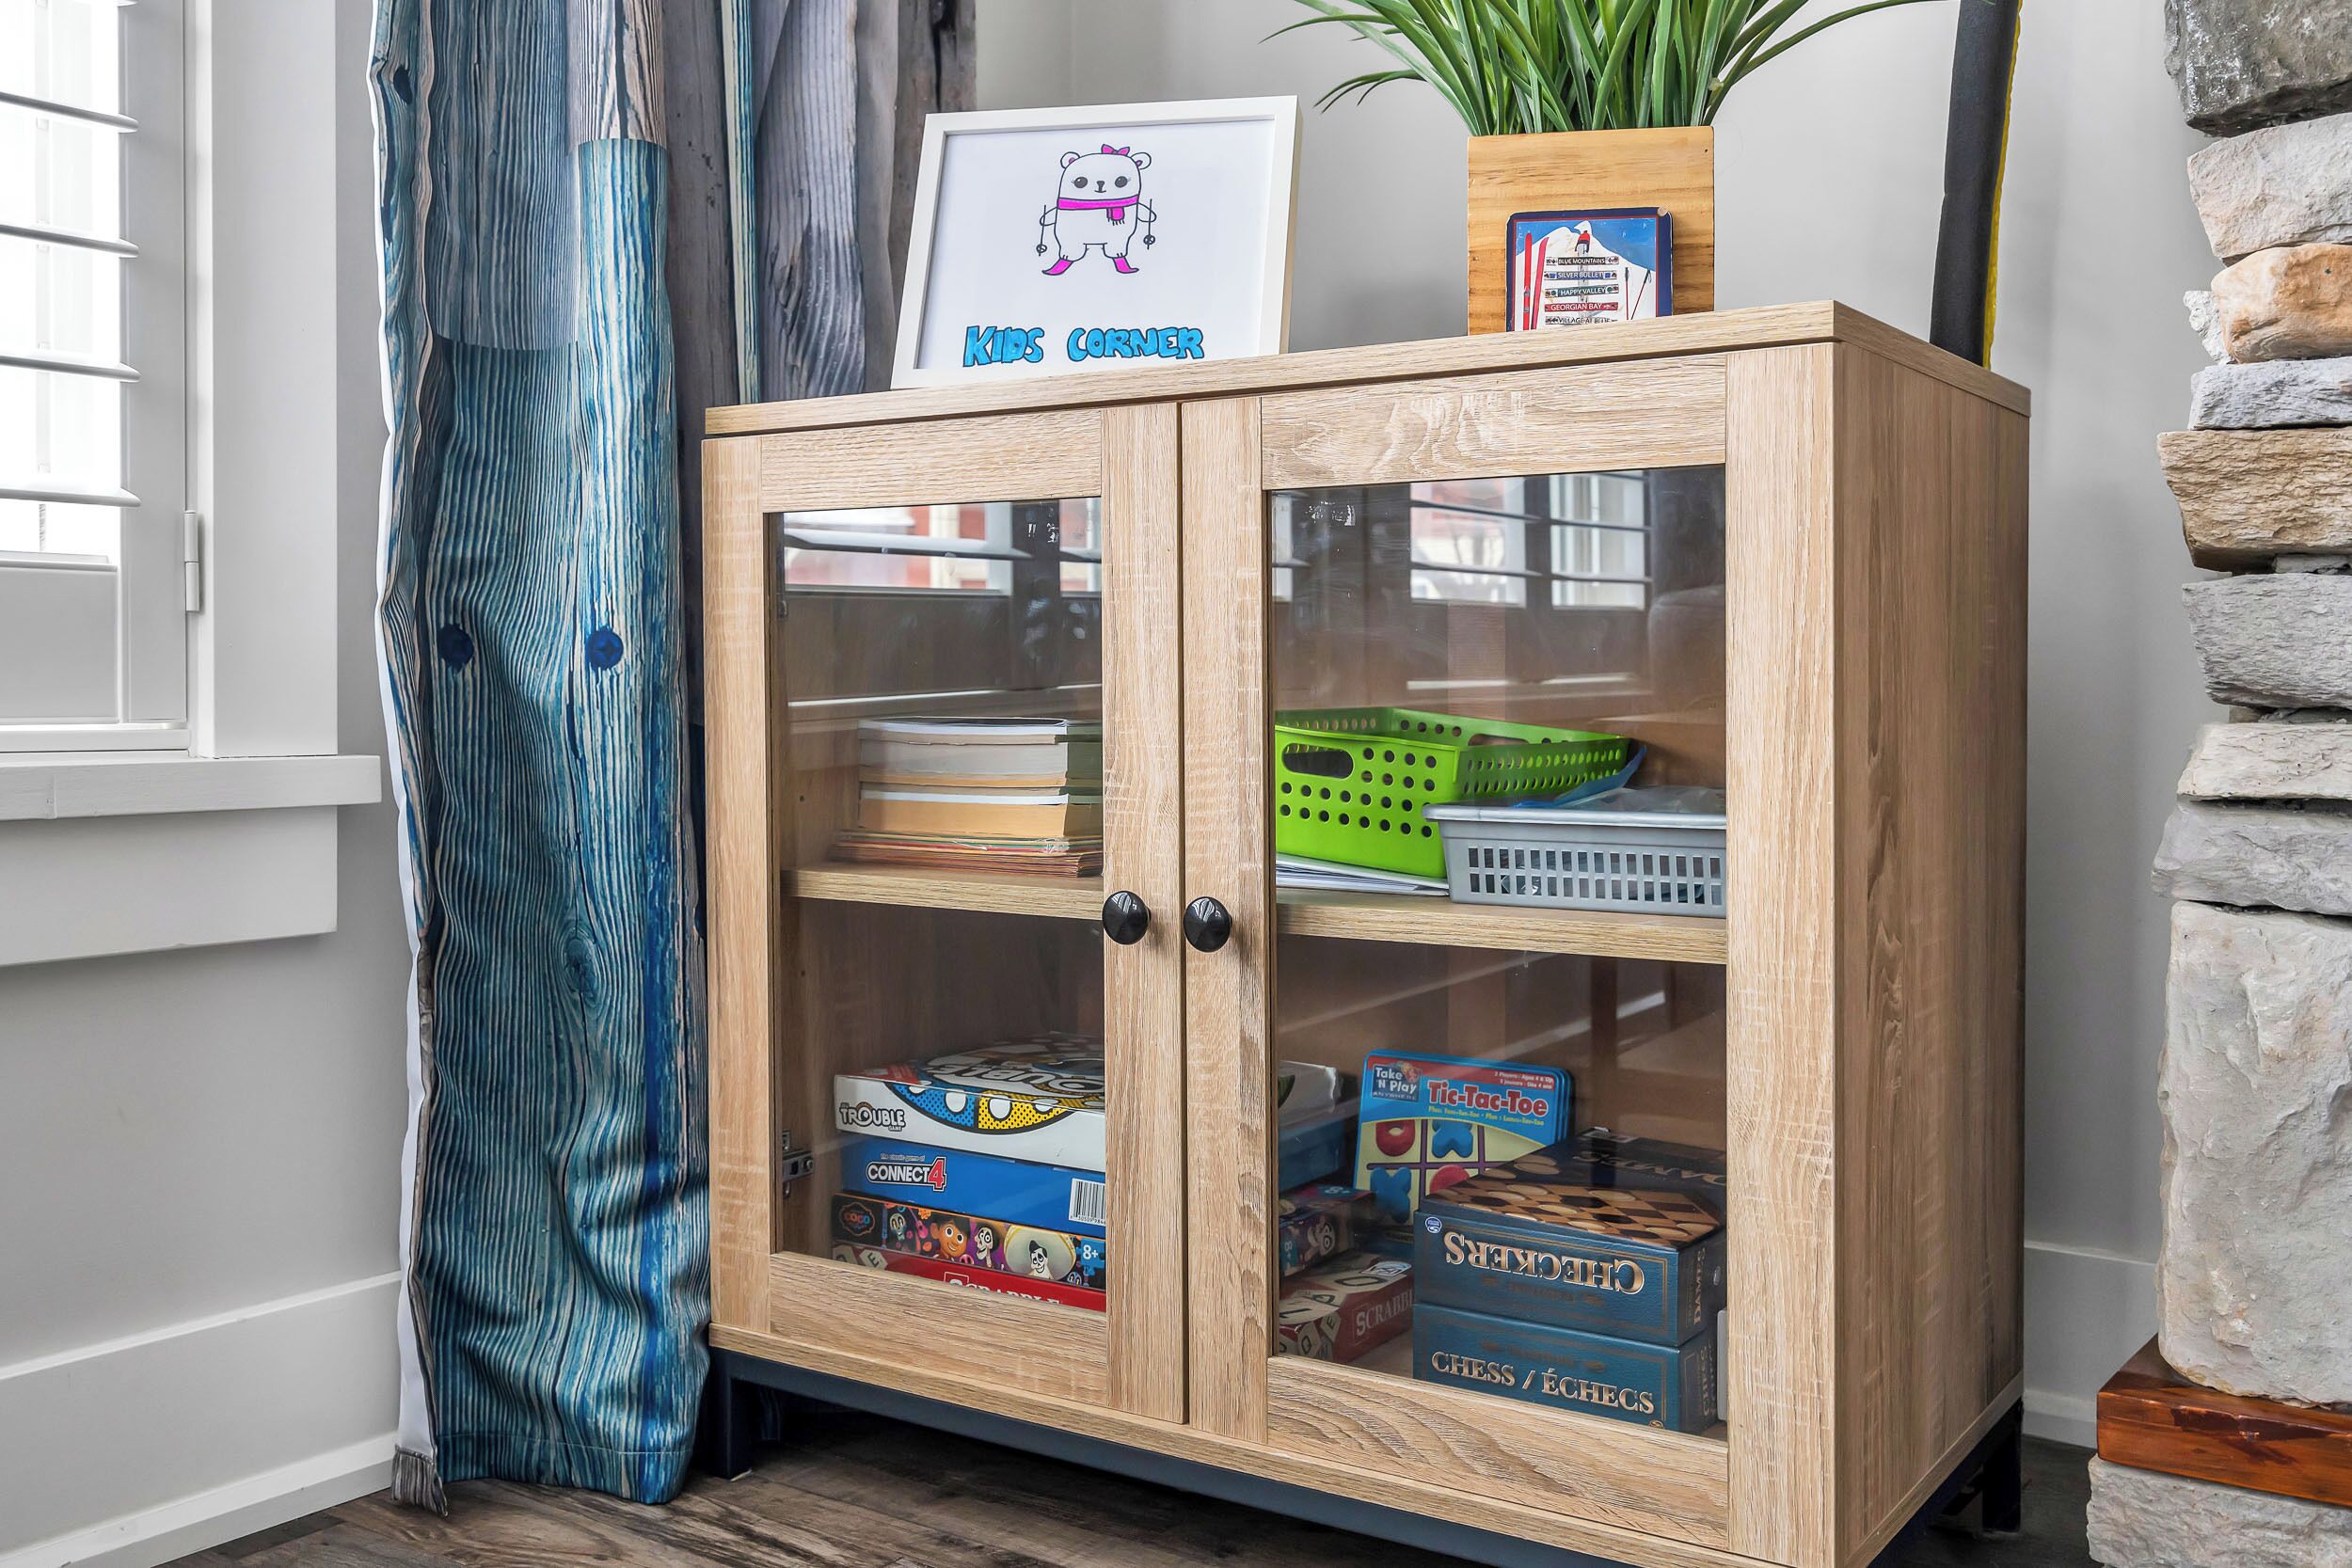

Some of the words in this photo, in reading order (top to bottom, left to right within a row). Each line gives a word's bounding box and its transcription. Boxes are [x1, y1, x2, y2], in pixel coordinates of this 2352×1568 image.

[1550, 303, 1587, 311] GEORGIAN
[962, 325, 1044, 368] KIDS
[1067, 326, 1204, 362] CORNER
[1375, 1067, 1404, 1081] Take
[1390, 1080, 1418, 1095] Play
[1427, 1080, 1549, 1117] Tic-Tac-Toe
[839, 1104, 907, 1128] TROUBLE
[1082, 1243, 1099, 1260] 8+
[1443, 1231, 1645, 1295] CHECKERS
[1356, 1288, 1414, 1337] SCRABBL
[1431, 1350, 1516, 1386] CHESS
[1541, 1368, 1655, 1415] ÉCHECS
